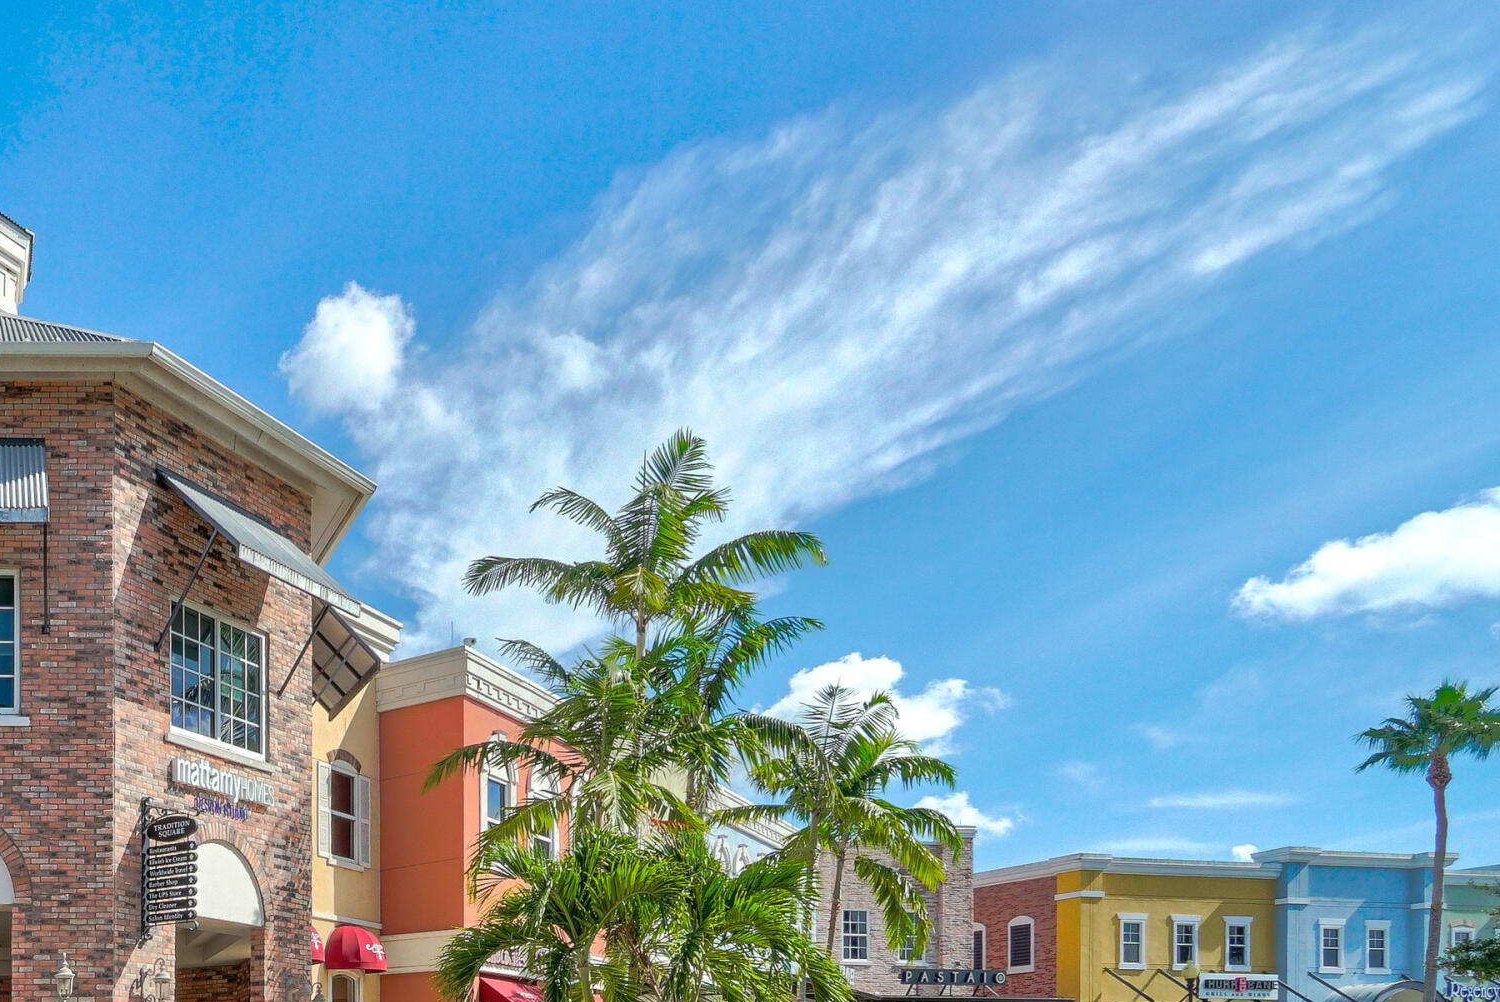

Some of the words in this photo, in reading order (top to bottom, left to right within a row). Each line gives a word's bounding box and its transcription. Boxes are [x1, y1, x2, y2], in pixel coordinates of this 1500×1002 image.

[154, 820, 190, 832] TRADITION
[158, 827, 186, 838] SQUARE
[149, 845, 177, 854] Restaurants
[172, 855, 188, 863] Cream
[149, 867, 174, 877] Worldwide
[175, 865, 188, 874] Travel
[148, 880, 165, 888] Barber
[165, 879, 179, 887] Shop
[158, 902, 177, 910] Cleaner
[148, 914, 163, 922] Salon
[164, 912, 183, 920] Identity
[904, 970, 1006, 985] PASTAIO
